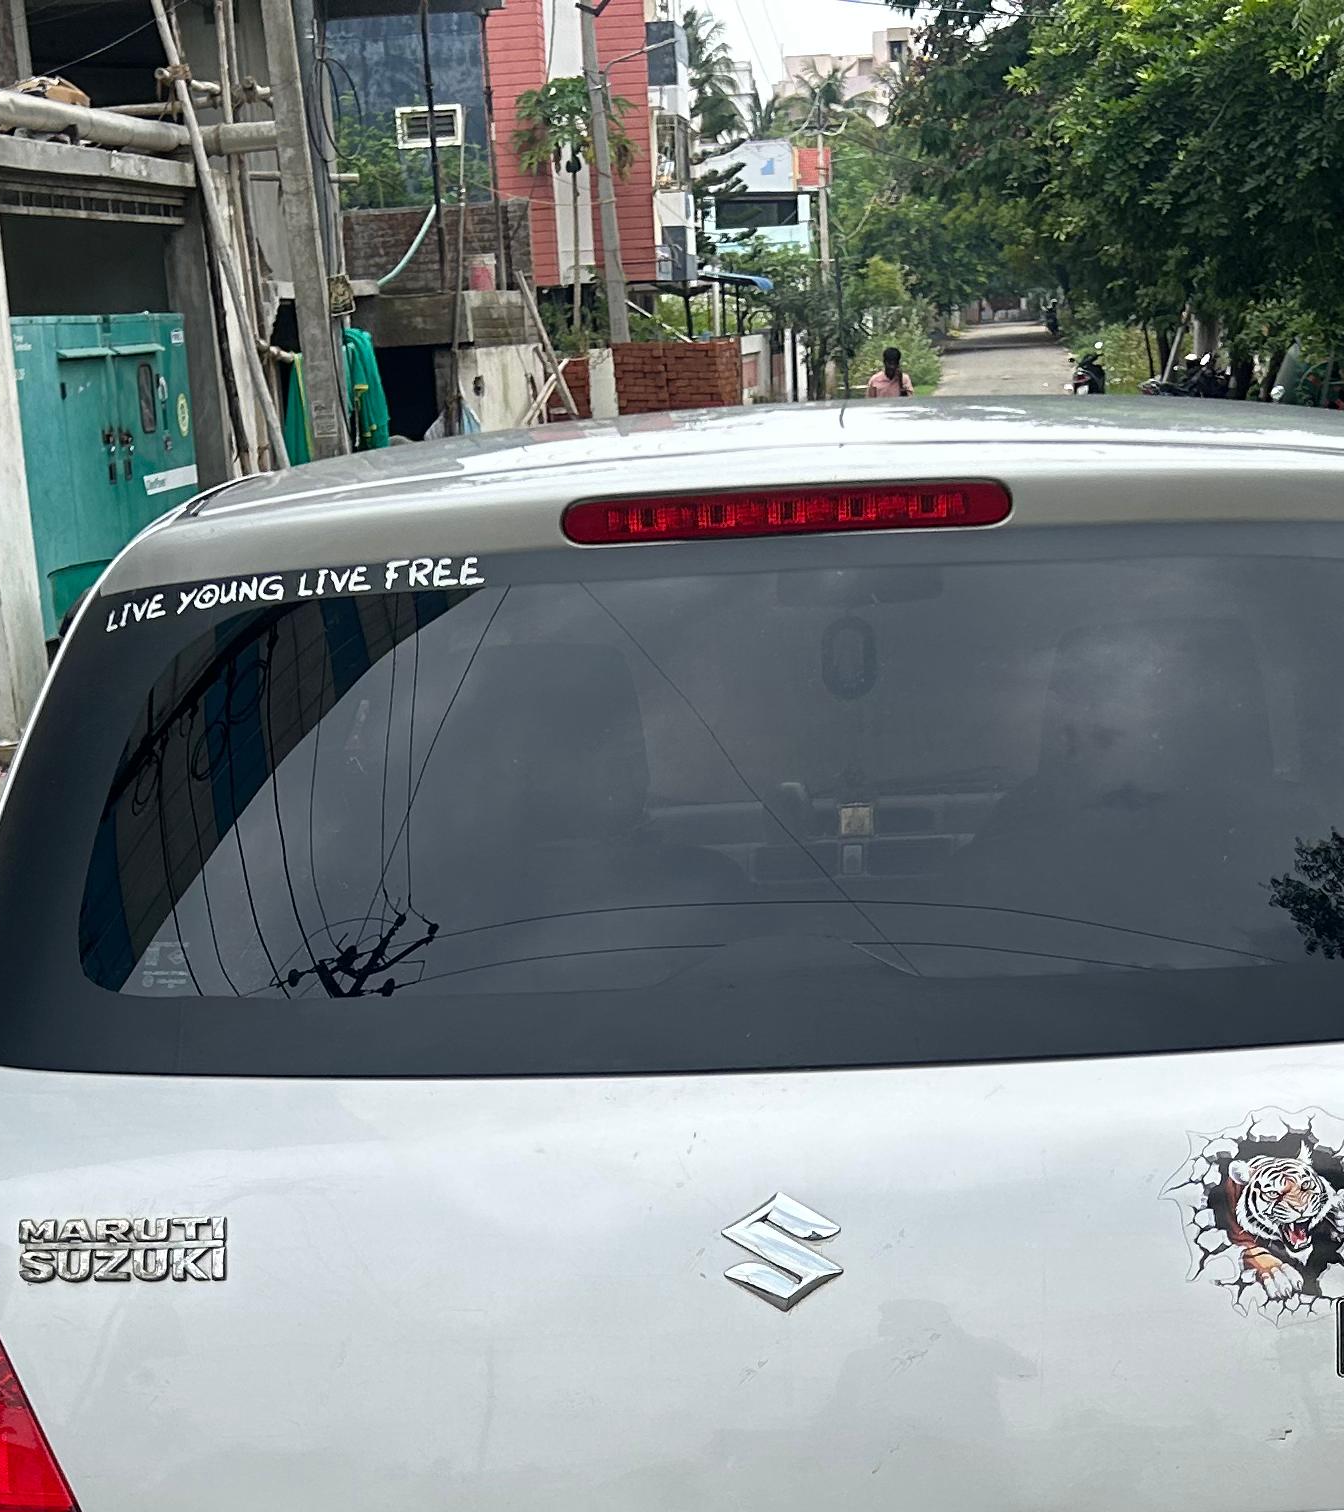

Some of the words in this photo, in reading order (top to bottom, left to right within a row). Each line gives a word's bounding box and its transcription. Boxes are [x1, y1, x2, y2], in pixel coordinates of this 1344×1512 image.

[106, 594, 166, 633] LIVE
[176, 576, 285, 615] YOUNG
[297, 567, 372, 596] LIVE
[384, 557, 485, 590] FREE
[18, 1216, 228, 1244] MARUTI
[18, 1246, 228, 1283] SUZUKI
